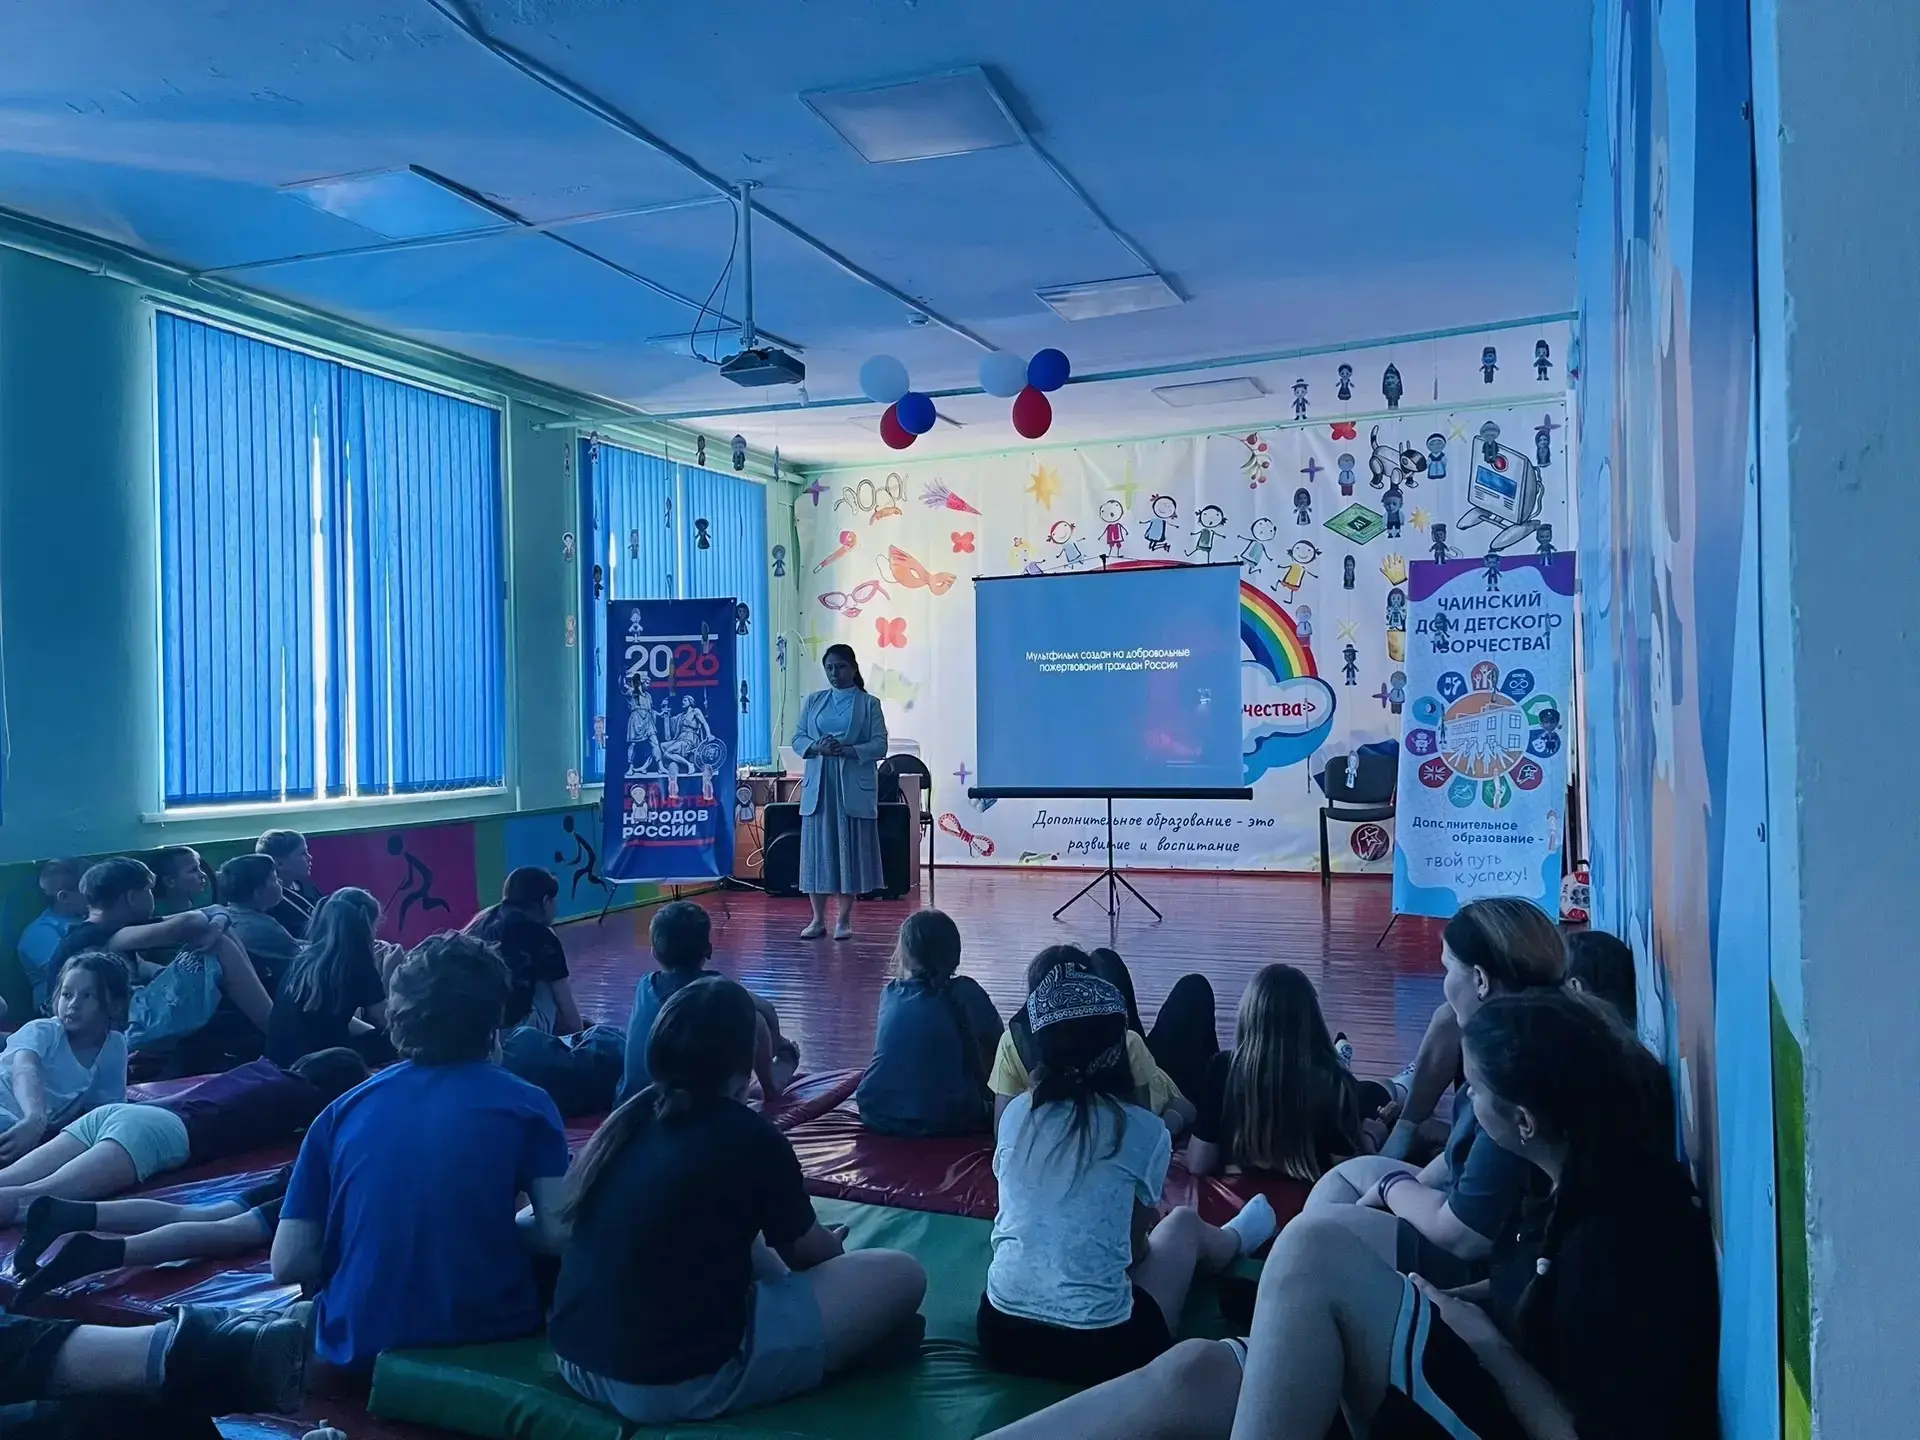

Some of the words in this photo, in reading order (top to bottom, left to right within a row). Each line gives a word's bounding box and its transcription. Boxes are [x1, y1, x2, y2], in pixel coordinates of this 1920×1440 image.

[1438, 590, 1541, 611] ЧАИНСКИЙ
[1464, 613, 1562, 634] ДЕТСКОГО
[624, 644, 720, 678] 2026
[1026, 651, 1079, 663] Мультфильм
[1080, 650, 1111, 660] создан
[1113, 651, 1124, 659] на
[1126, 648, 1190, 661] добровольные
[1039, 662, 1104, 673] пожертвования
[1105, 660, 1143, 672] граждан
[1145, 660, 1178, 670] России
[1241, 702, 1316, 717] чества»
[622, 810, 709, 825] НРОДОВ
[1147, 812, 1232, 832] образование
[1248, 817, 1275, 828] это
[1412, 816, 1518, 830] Дополнительное
[622, 825, 697, 839] РОССИИ
[1452, 832, 1534, 844] образование
[1140, 840, 1147, 850] и
[1157, 837, 1240, 852] воспитание
[1467, 854, 1502, 869] путь
[1468, 867, 1528, 887] успеху!
